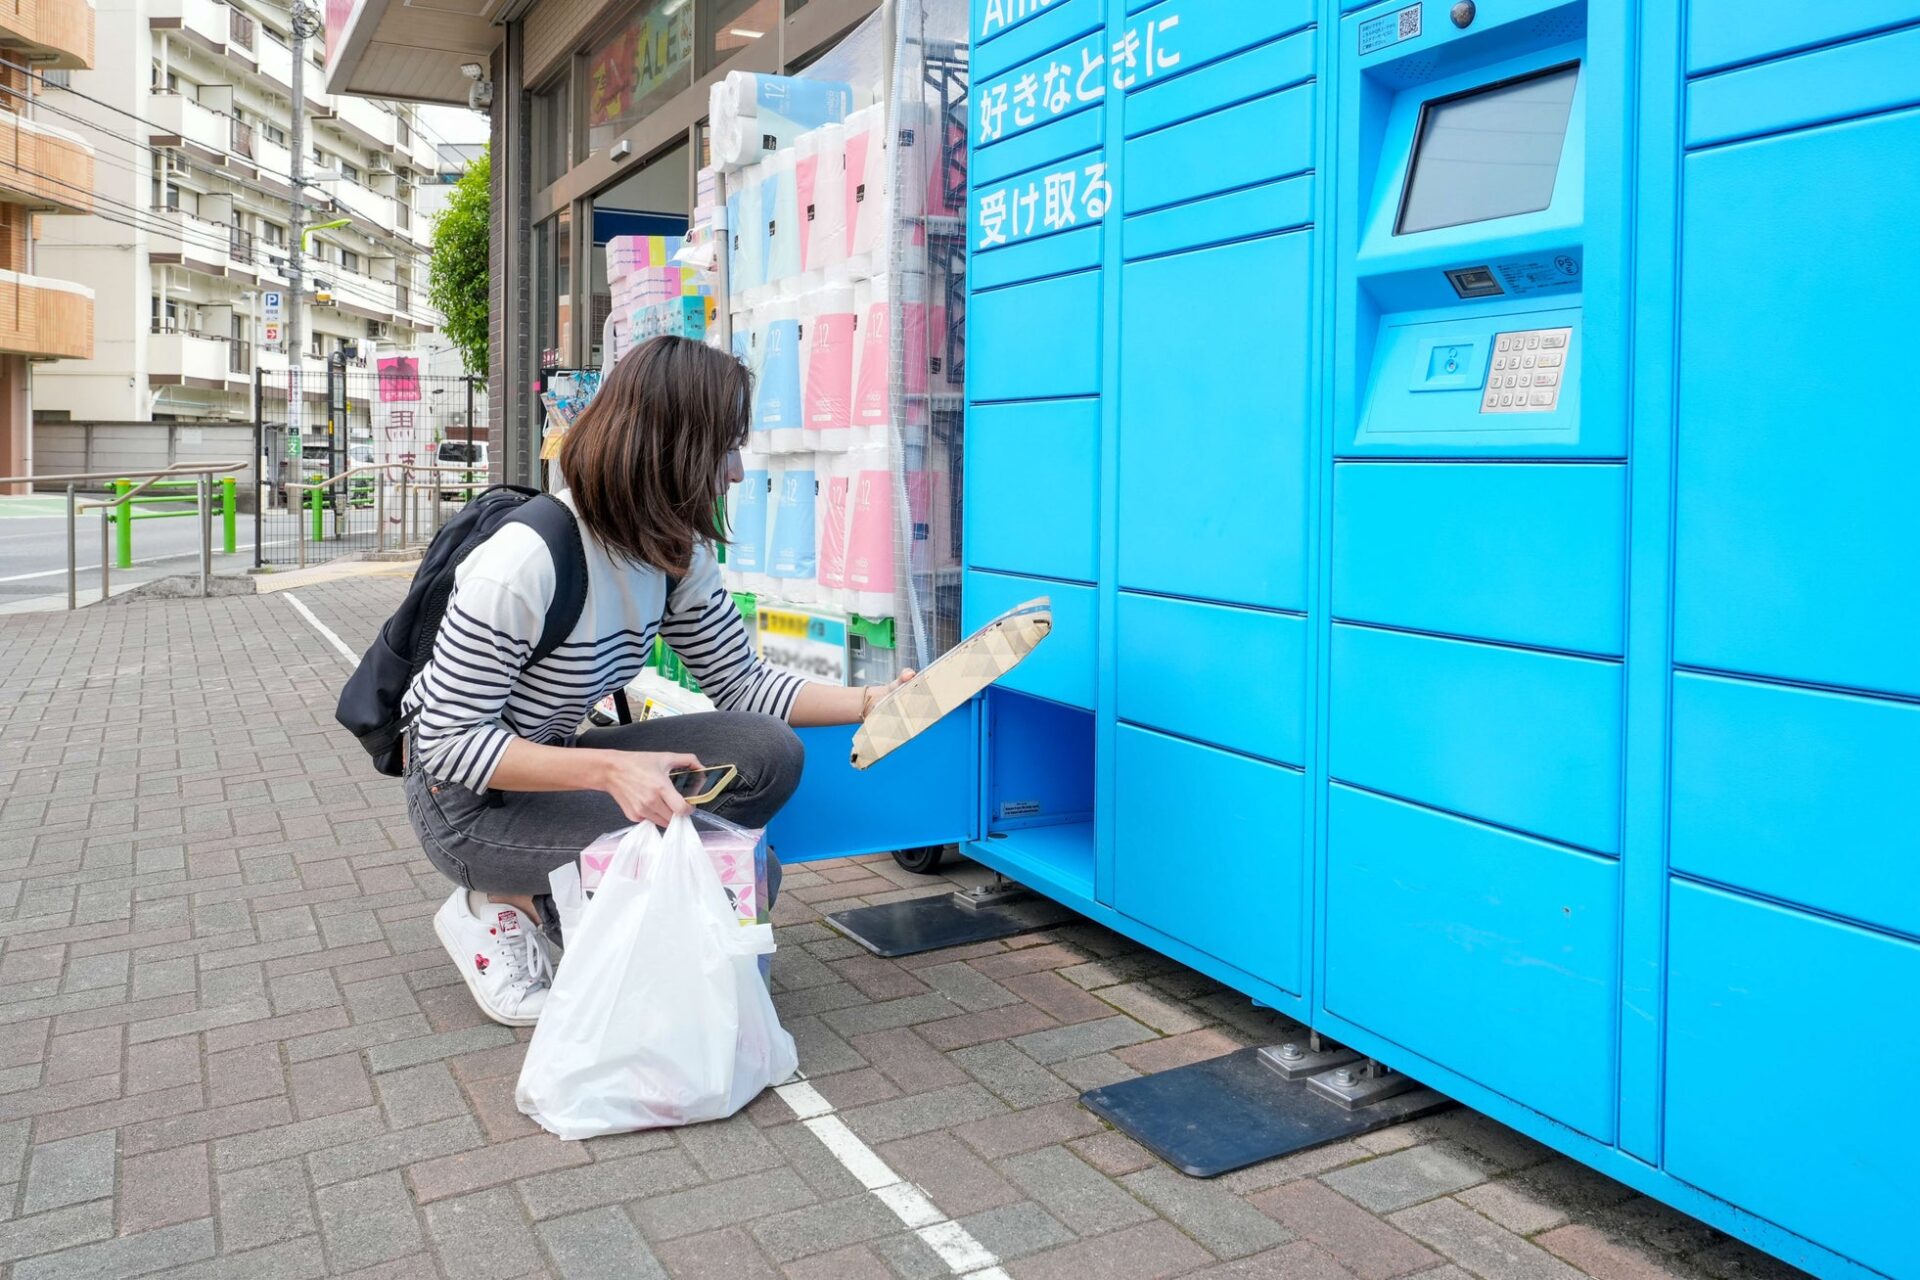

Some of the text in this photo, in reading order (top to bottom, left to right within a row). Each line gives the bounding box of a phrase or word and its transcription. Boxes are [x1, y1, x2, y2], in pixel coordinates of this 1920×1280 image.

[764, 82, 785, 99] 12
[980, 15, 1180, 143] 好きなときに
[979, 162, 1113, 248] 受け取る
[267, 294, 278, 306] P
[819, 323, 830, 348] 12
[872, 312, 884, 338] 12
[771, 328, 782, 353] 12
[745, 478, 755, 500] 12
[787, 478, 798, 502] 12
[832, 486, 843, 506] 12
[861, 479, 871, 505] 12
